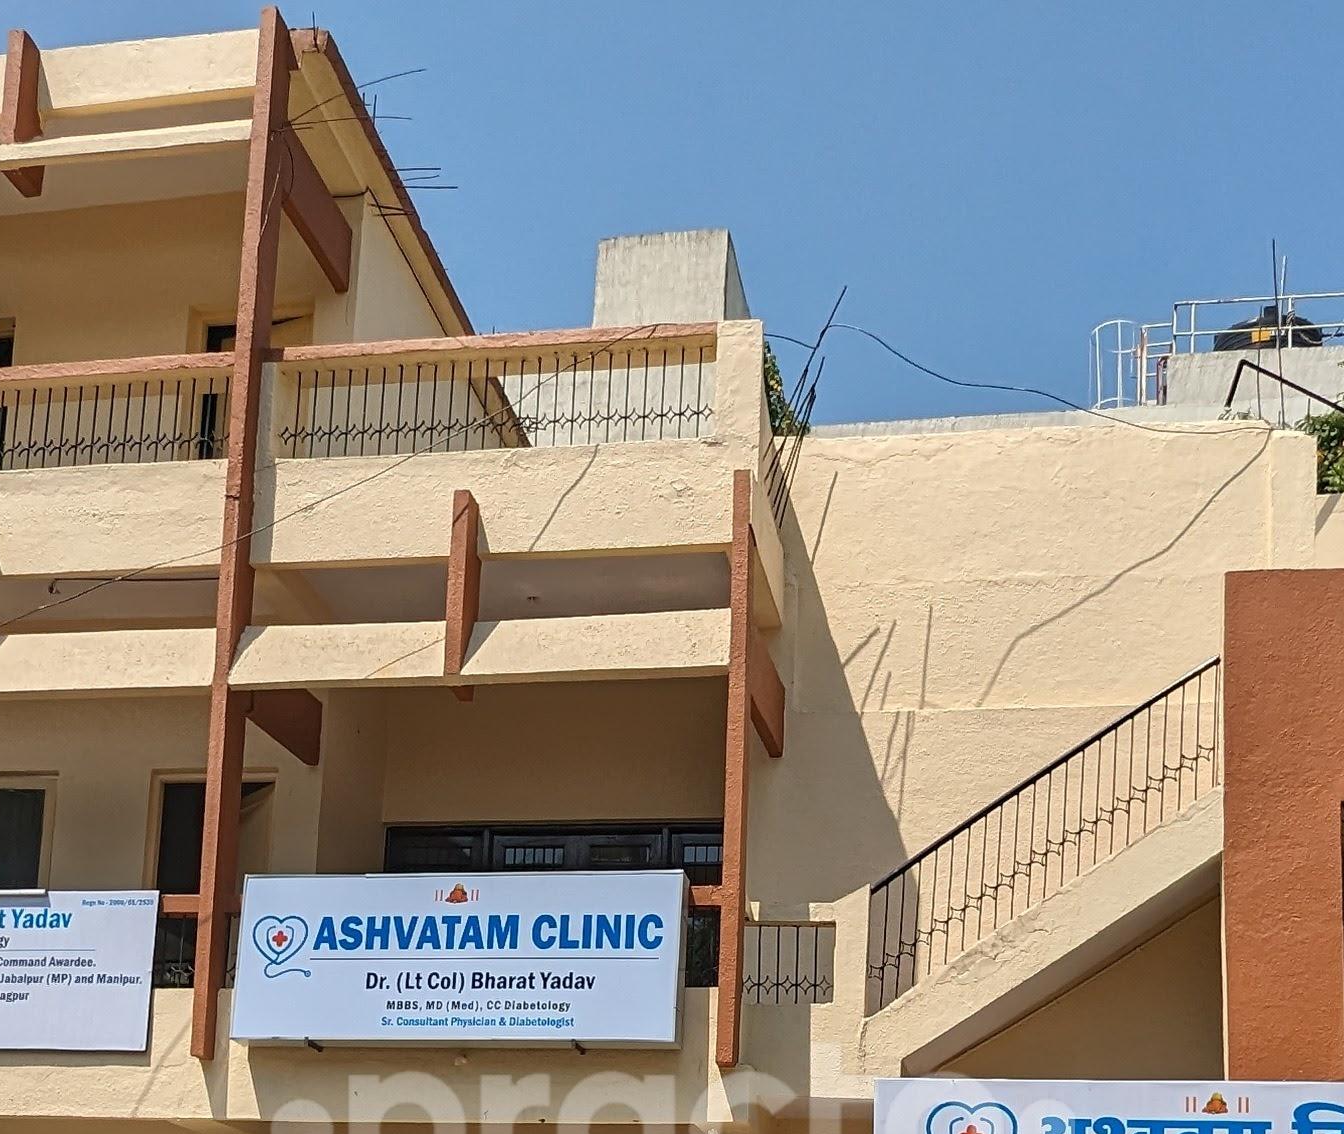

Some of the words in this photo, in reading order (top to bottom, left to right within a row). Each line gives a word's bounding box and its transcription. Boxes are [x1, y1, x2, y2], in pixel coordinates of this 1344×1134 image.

[11, 908, 72, 930] Yadav
[312, 914, 520, 951] ASHVATAM
[531, 913, 665, 951] CLINIC
[48, 956, 97, 968] Awardee.
[0, 973, 45, 986] Jabalpur
[46, 973, 72, 986] (MP)
[74, 973, 94, 985] and
[96, 973, 143, 987] Manipur.
[365, 972, 391, 991] Dr.
[396, 971, 424, 995] (Lt
[427, 971, 465, 995] Col)
[471, 971, 535, 991] Bharat
[539, 971, 596, 991] Yadav
[386, 1000, 423, 1012] MBBS,
[426, 1000, 444, 1011] MD
[445, 1000, 483, 1013] (Med),
[486, 1000, 503, 1011] CC
[504, 1000, 571, 1013] Diabetology
[381, 1016, 394, 1027] Sr.
[396, 1016, 449, 1027] Consultant
[451, 1016, 497, 1029] Physician
[499, 1016, 507, 1027] &
[509, 1016, 575, 1029] Diabetologist
